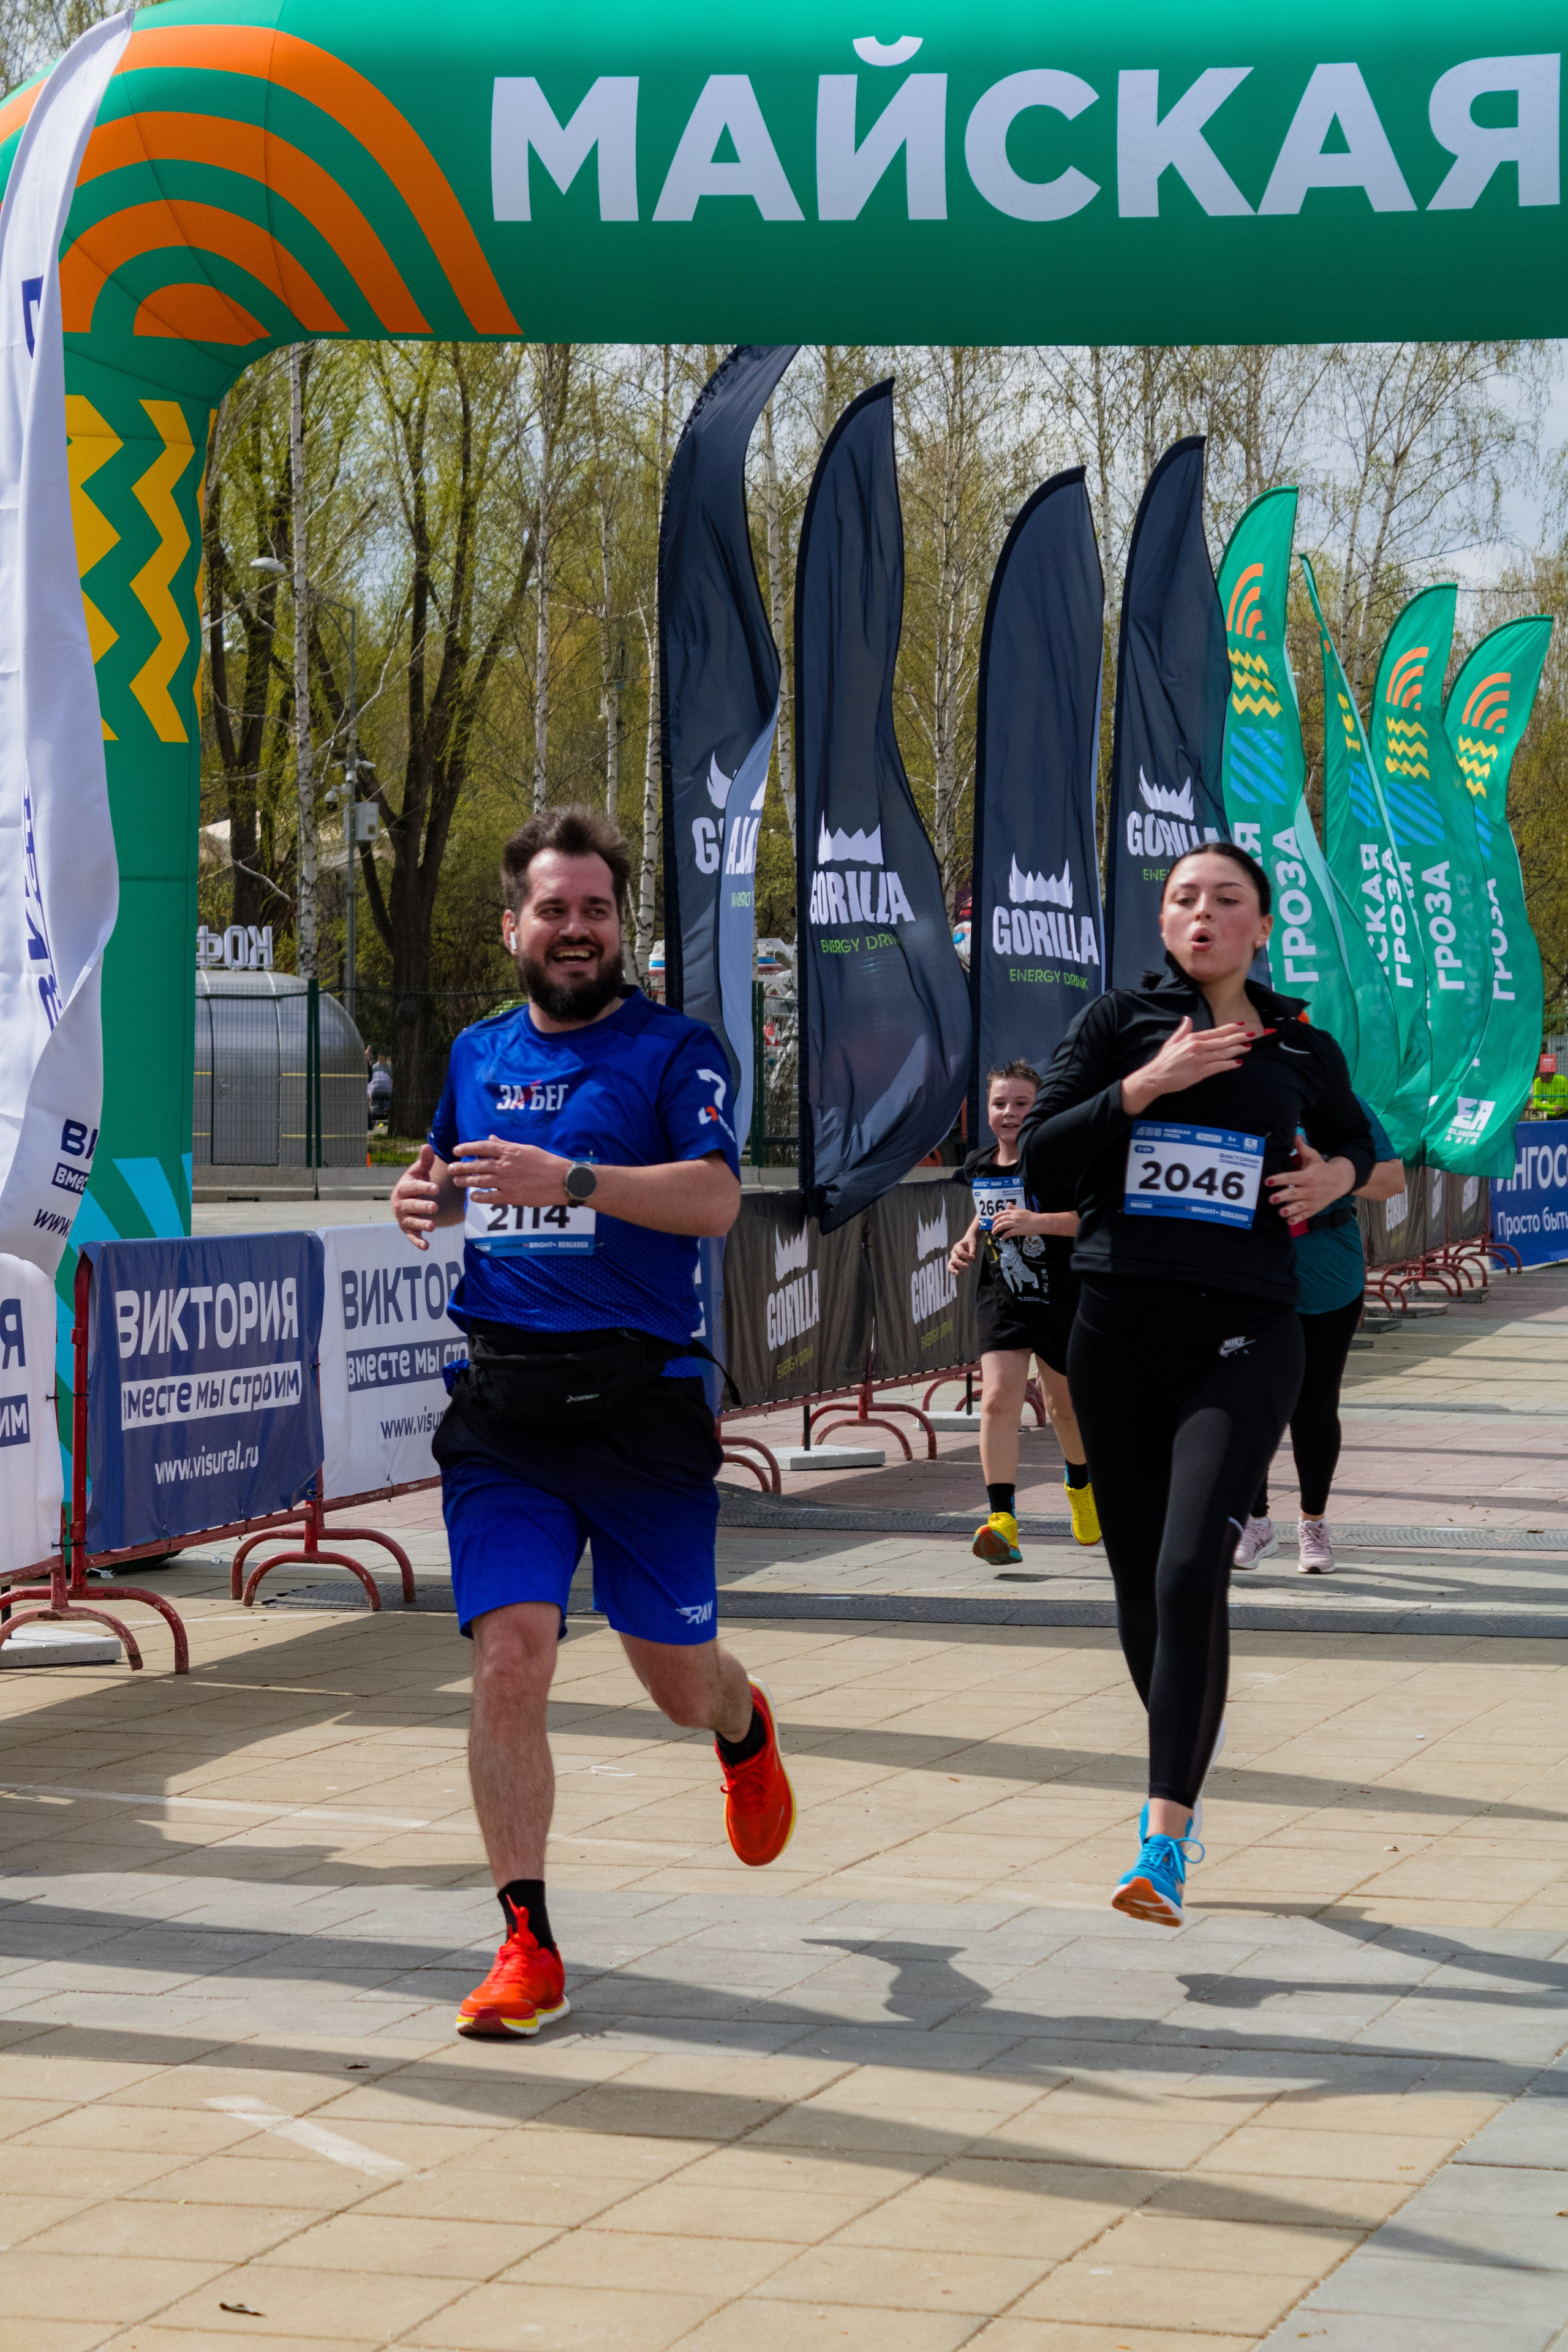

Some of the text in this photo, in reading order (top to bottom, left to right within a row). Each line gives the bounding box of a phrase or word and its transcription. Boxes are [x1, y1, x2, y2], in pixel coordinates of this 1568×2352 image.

[491, 35, 1561, 222] МАЙСКАЯ
[1143, 869, 1169, 881] ENE
[809, 870, 916, 925] GORILLA
[1272, 826, 1319, 982] ГРОЗА
[1382, 846, 1414, 988] ГРОЗА
[821, 937, 860, 954] ENERGY
[992, 905, 1100, 966] GORILLA
[1421, 860, 1466, 990] ГРОЗА
[1009, 968, 1089, 990] ENERGY DRINK
[1444, 1134, 1477, 1145] ASIA
[1447, 1128, 1482, 1139] EUROPE
[1139, 1160, 1246, 1200] 2046
[487, 1203, 570, 1232] 2114
[1497, 1210, 1540, 1242] Просто
[767, 1268, 820, 1351] GORILLA
[911, 1253, 958, 1324] GORILLA
[115, 1277, 299, 1359] ВИКТОРИЯ
[415, 1346, 440, 1374] мы
[777, 1352, 799, 1379] ENERGY
[196, 1378, 225, 1410] мы
[229, 1368, 300, 1411] строим
[154, 1439, 259, 1485] www.visural.ru
